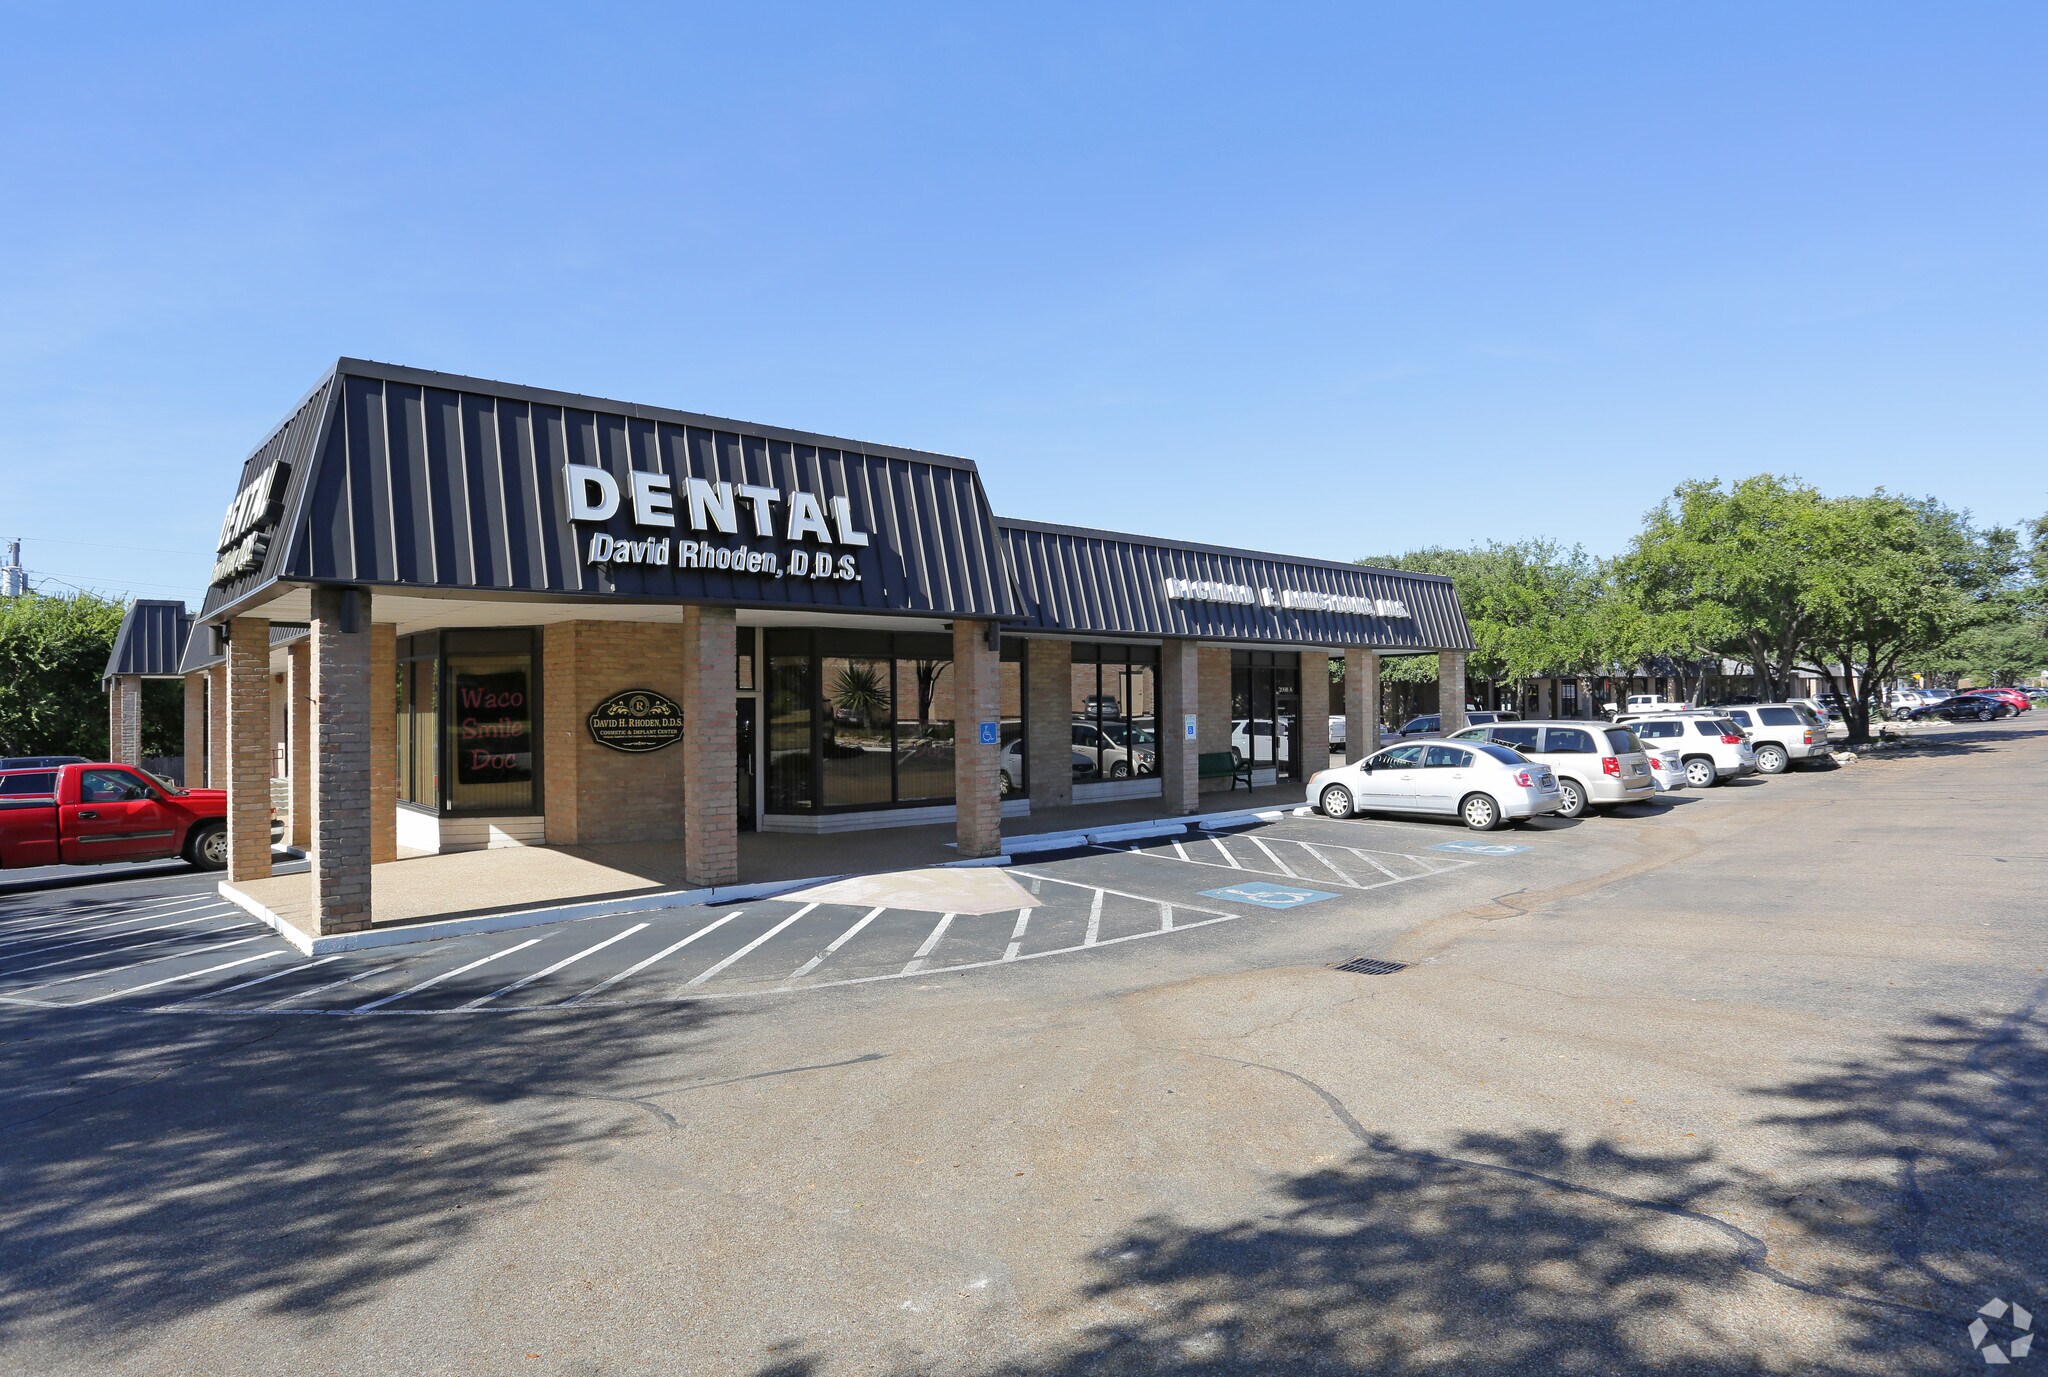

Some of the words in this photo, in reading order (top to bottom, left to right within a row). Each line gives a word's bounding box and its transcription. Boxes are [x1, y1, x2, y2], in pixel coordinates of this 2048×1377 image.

[562, 463, 869, 546] DENTAL
[588, 532, 670, 566] David
[678, 540, 783, 578] Rhoden,
[788, 549, 862, 581] D.D.S.
[461, 687, 523, 708] Waco
[462, 717, 524, 739] Smile
[593, 719, 618, 728] DAVID
[619, 718, 628, 727] H.
[628, 718, 661, 728] RHODEN,
[662, 718, 684, 727] D.D.S.
[471, 749, 517, 770] Doc
